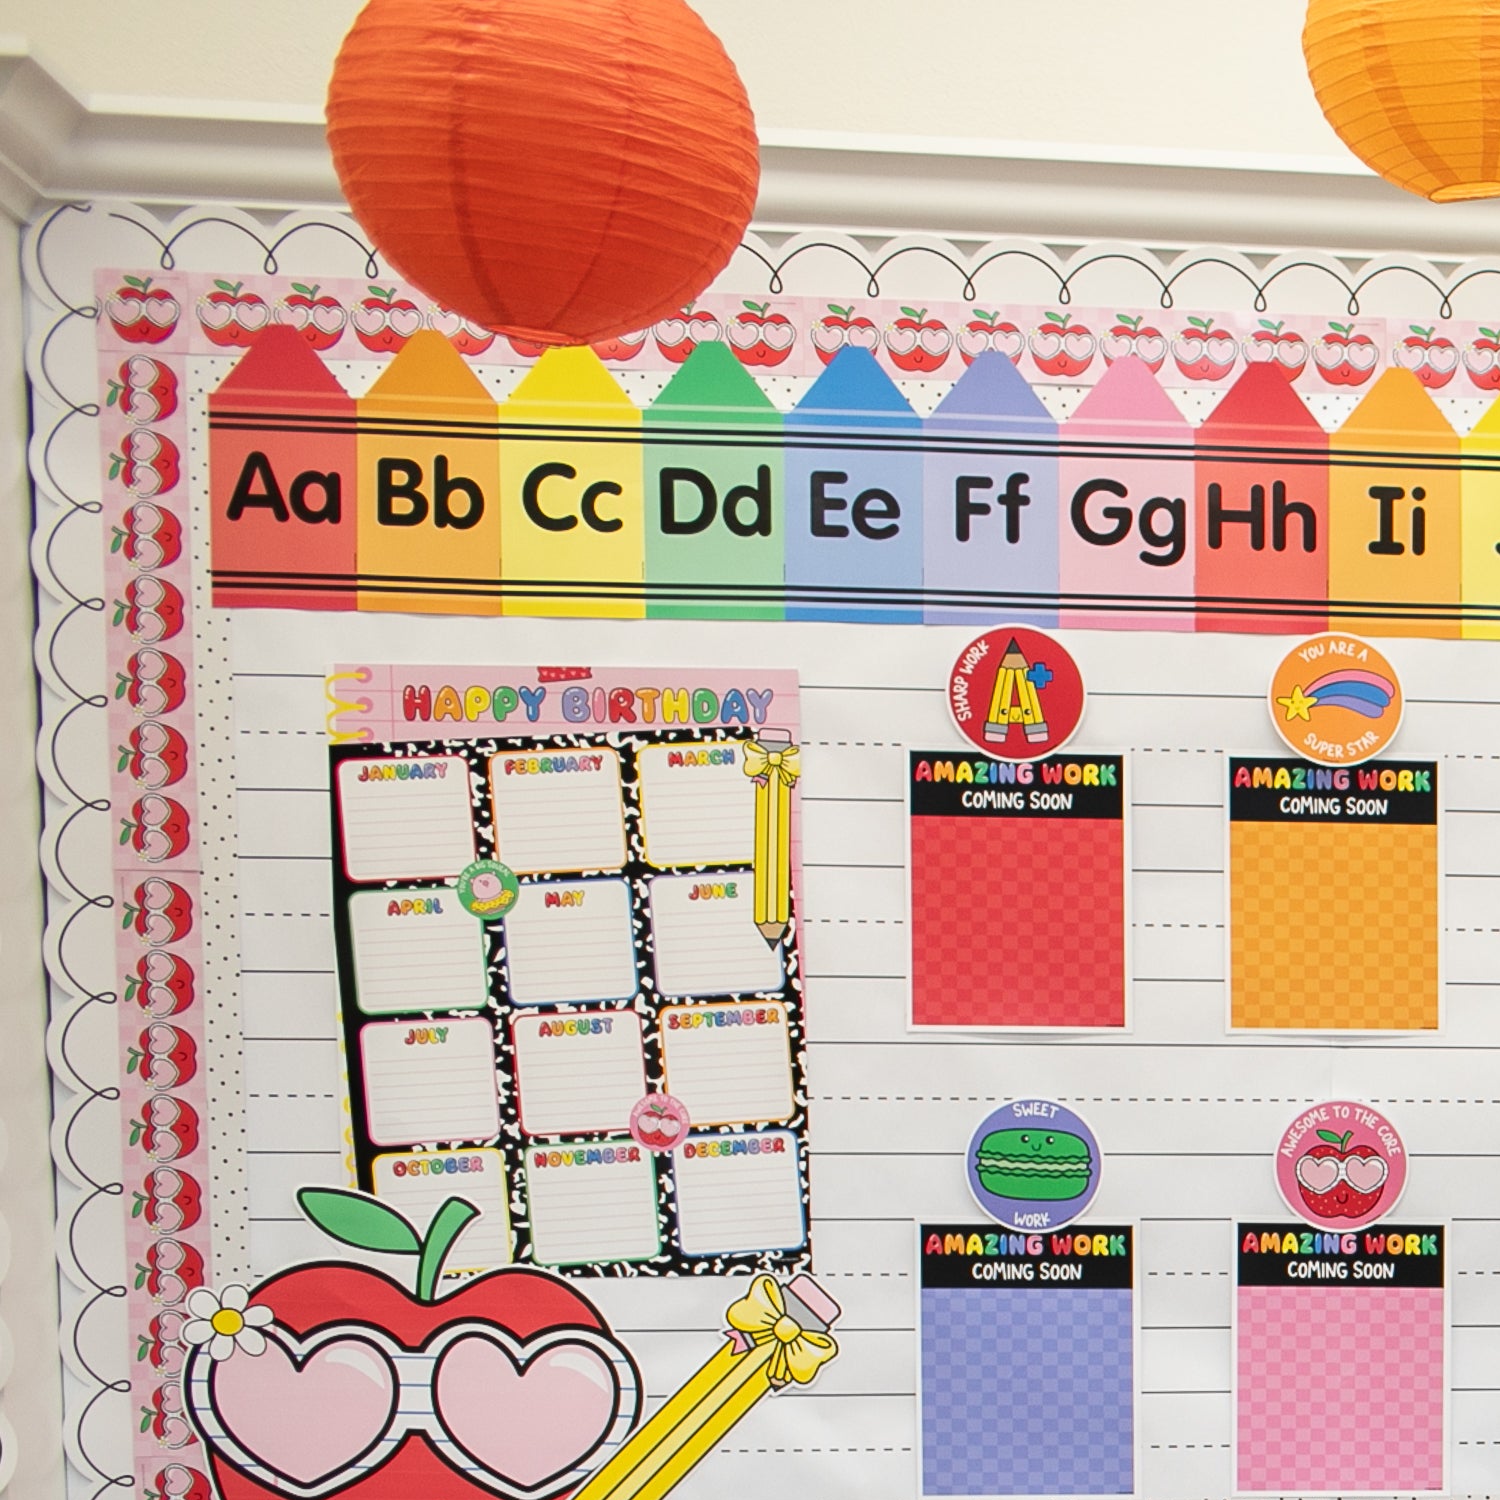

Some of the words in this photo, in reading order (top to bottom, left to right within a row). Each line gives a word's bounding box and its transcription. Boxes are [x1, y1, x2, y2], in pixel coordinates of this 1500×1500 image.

[226, 451, 343, 525] Aa
[376, 455, 485, 529] Bb
[520, 463, 623, 533] Cc
[659, 465, 772, 537] Dd
[809, 471, 900, 540] Ee
[955, 472, 1030, 544] Ff
[1070, 478, 1186, 566] Gg
[1207, 480, 1317, 552] Hh
[1367, 486, 1426, 556] Ii
[961, 639, 989, 676] WORK
[1298, 642, 1326, 663] YOU
[1328, 642, 1354, 658] ARE
[1356, 648, 1369, 662] A
[403, 685, 546, 723] HAPPY
[562, 686, 773, 725] BIRTHDAY
[955, 676, 973, 722] SHARP
[1303, 732, 1344, 759] SUPER
[1345, 730, 1380, 756] STAR
[358, 762, 449, 782] JANUARY
[504, 754, 603, 776] FEBRUARY
[667, 749, 735, 767] MARCH
[915, 760, 1034, 784] AMAZING
[1041, 763, 1116, 787] WORK
[1234, 766, 1349, 792] AMAZING
[1357, 768, 1431, 793] WORK
[962, 790, 1024, 811] COMING
[1030, 792, 1073, 811] SOON
[1279, 796, 1340, 816] COMING
[1345, 797, 1388, 817] SOON
[387, 898, 443, 916] APRIL
[544, 890, 585, 907] MAY
[688, 883, 737, 901] JUNE
[404, 1027, 450, 1044] JULY
[538, 1017, 614, 1037] AUGUST
[668, 1008, 779, 1029] SEPTEMBER
[1012, 1102, 1059, 1119] SWEET
[1280, 1110, 1330, 1159] AWESOME
[1332, 1104, 1349, 1121] TO
[1353, 1106, 1379, 1129] THE
[1376, 1123, 1402, 1158] CORE
[392, 1155, 483, 1177] OCTOBER
[534, 1145, 640, 1169] NOVEMBER
[683, 1138, 786, 1159] DECEMBER
[1014, 1212, 1050, 1228] WORK
